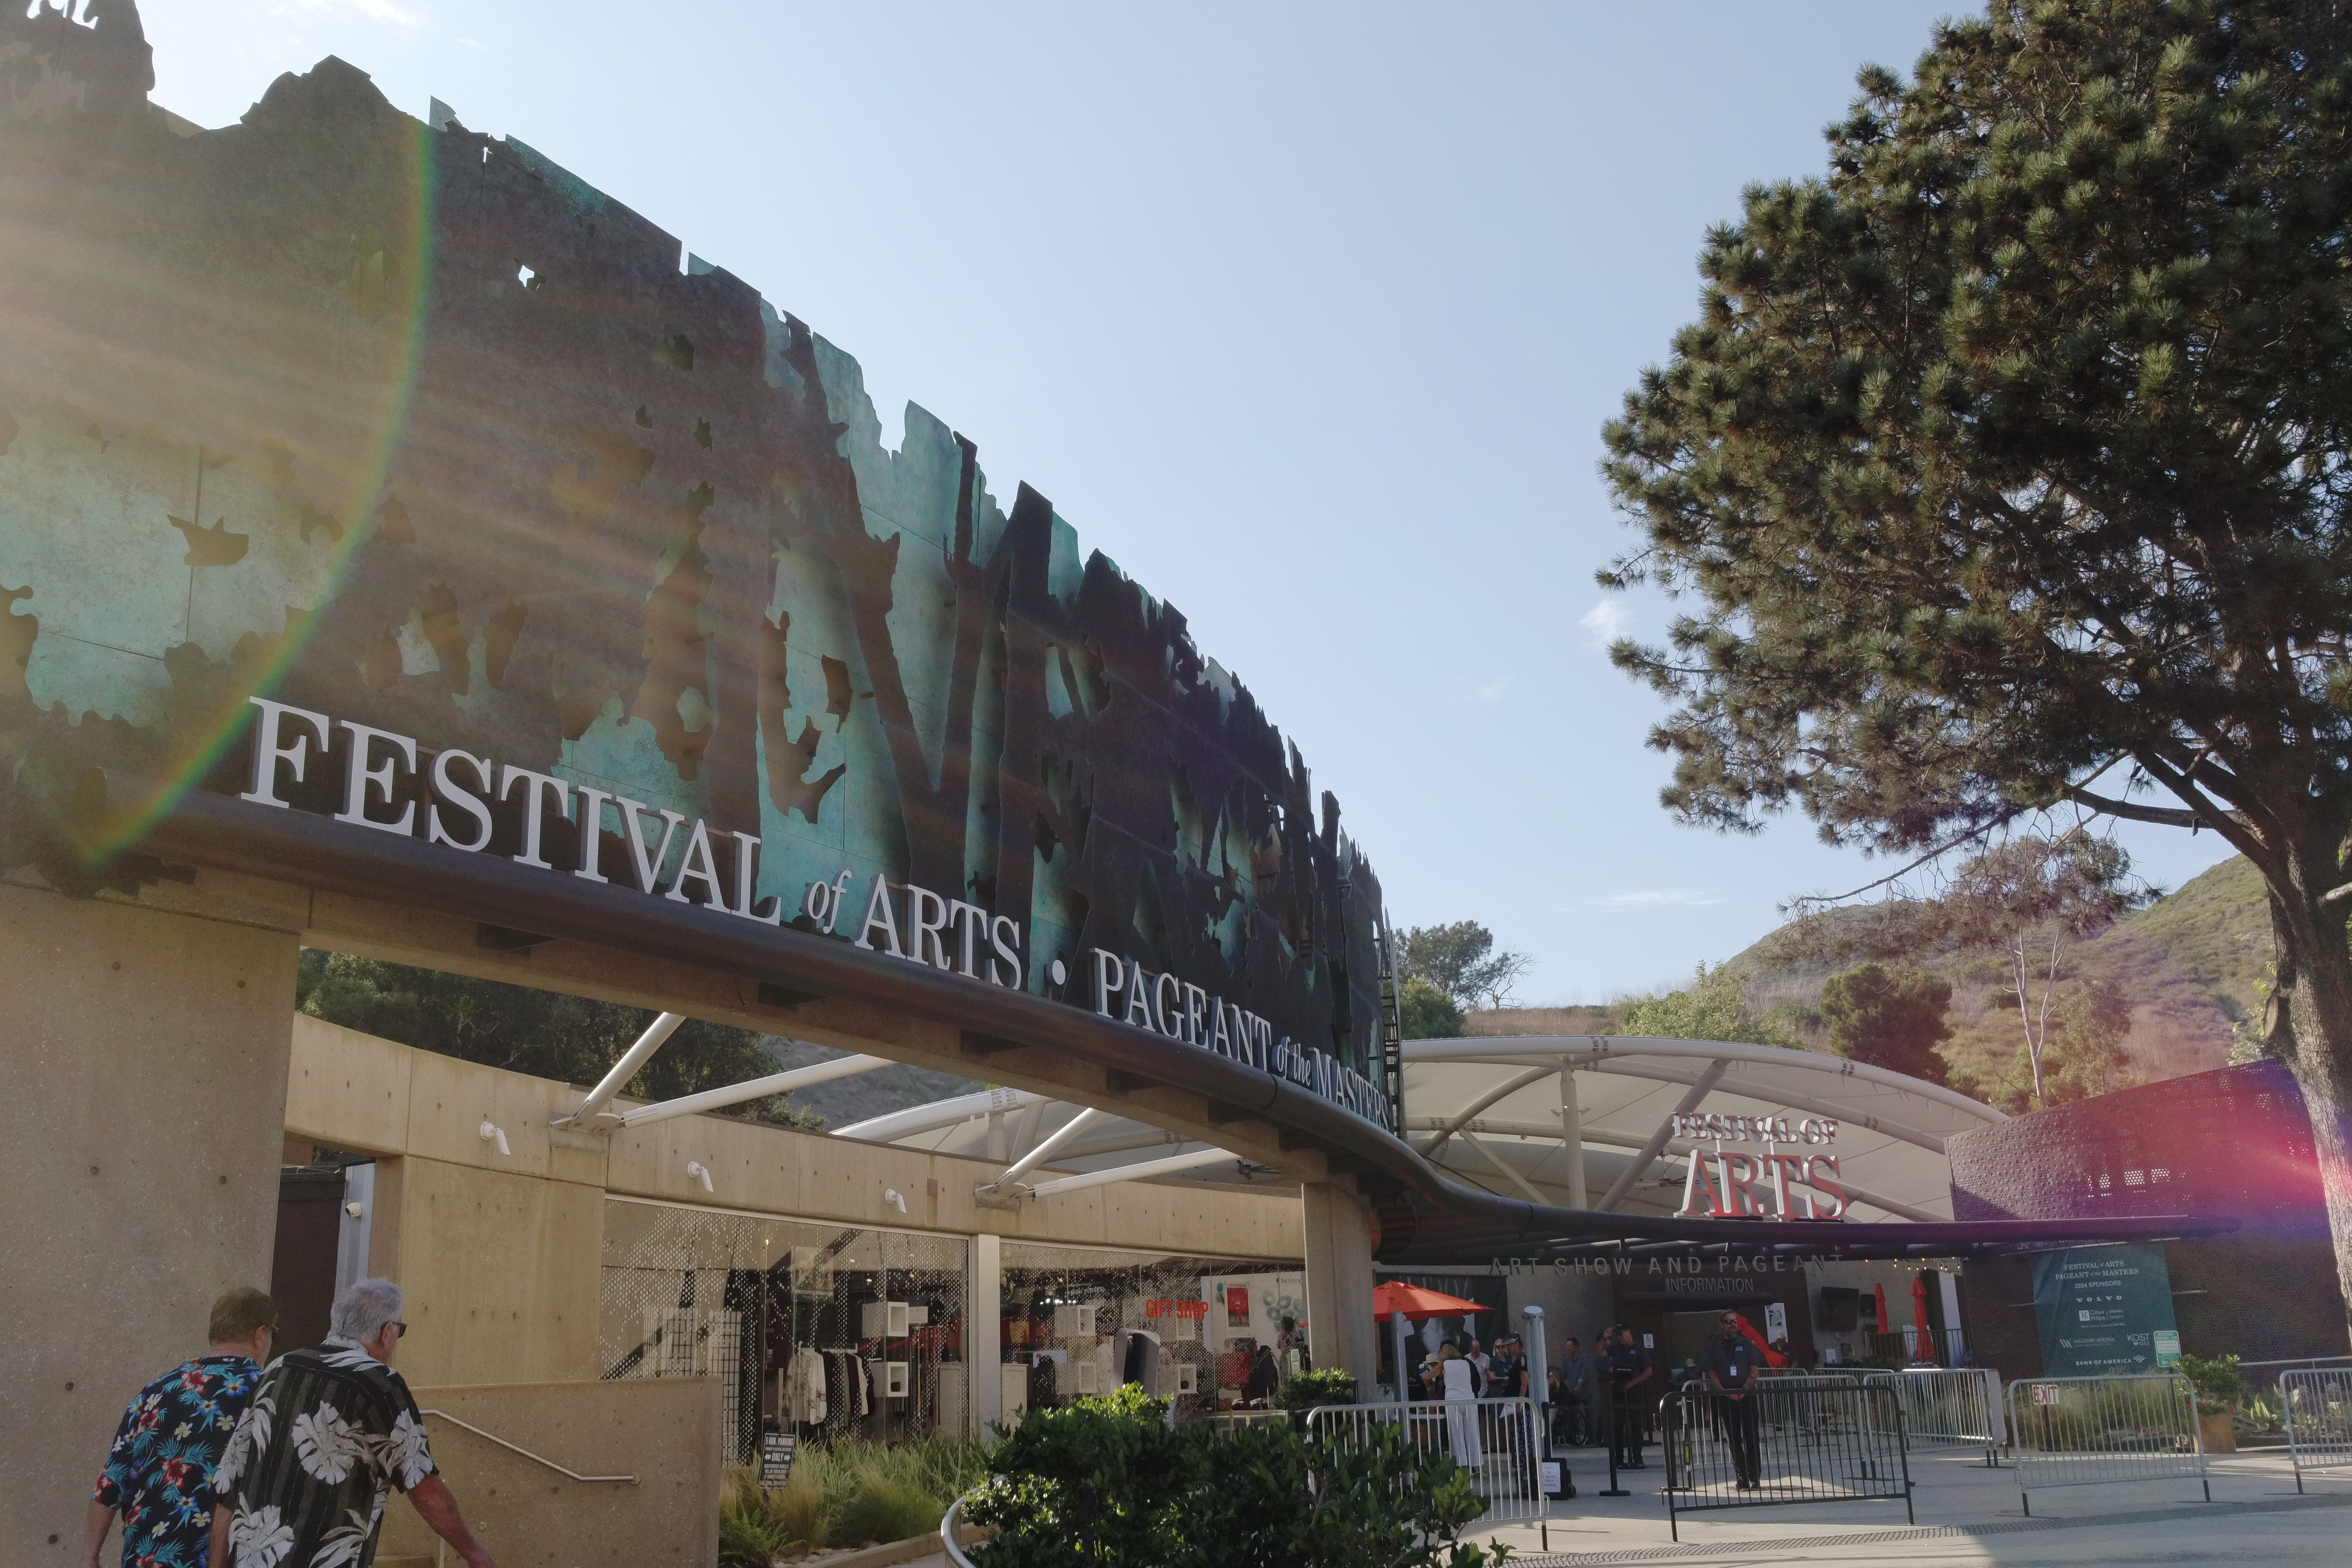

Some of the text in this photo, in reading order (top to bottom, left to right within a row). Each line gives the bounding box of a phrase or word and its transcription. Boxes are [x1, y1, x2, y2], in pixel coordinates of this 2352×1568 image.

[240, 695, 781, 926] FESTIVAL
[805, 869, 852, 935] of
[854, 873, 1022, 991] ARTS
[1090, 947, 1272, 1072] PAGEANT
[1275, 1036, 1290, 1079] of
[1292, 1043, 1311, 1086] the
[1310, 1046, 1389, 1131] MASTERS
[1672, 1112, 1839, 1145] FESTIVAL OF
[1673, 1149, 1847, 1220] ARTS
[1489, 1257, 1540, 1276] ART
[1554, 1257, 1632, 1275] SHOW
[1648, 1256, 1701, 1274] AND
[2054, 1271, 2089, 1280] PAGEANT
[2102, 1268, 2139, 1277] MASTERS
[2064, 1262, 2099, 1270] FESTIVAL
[1665, 1277, 1754, 1292] INFORMATION
[1146, 1298, 1209, 1320] GIFT SHOP
[2127, 1333, 2150, 1342] KOST
[2033, 1386, 2057, 1403] EXIT
[765, 1437, 794, 1446] 5 MIN. PARKING
[771, 1452, 784, 1461] ONLY
